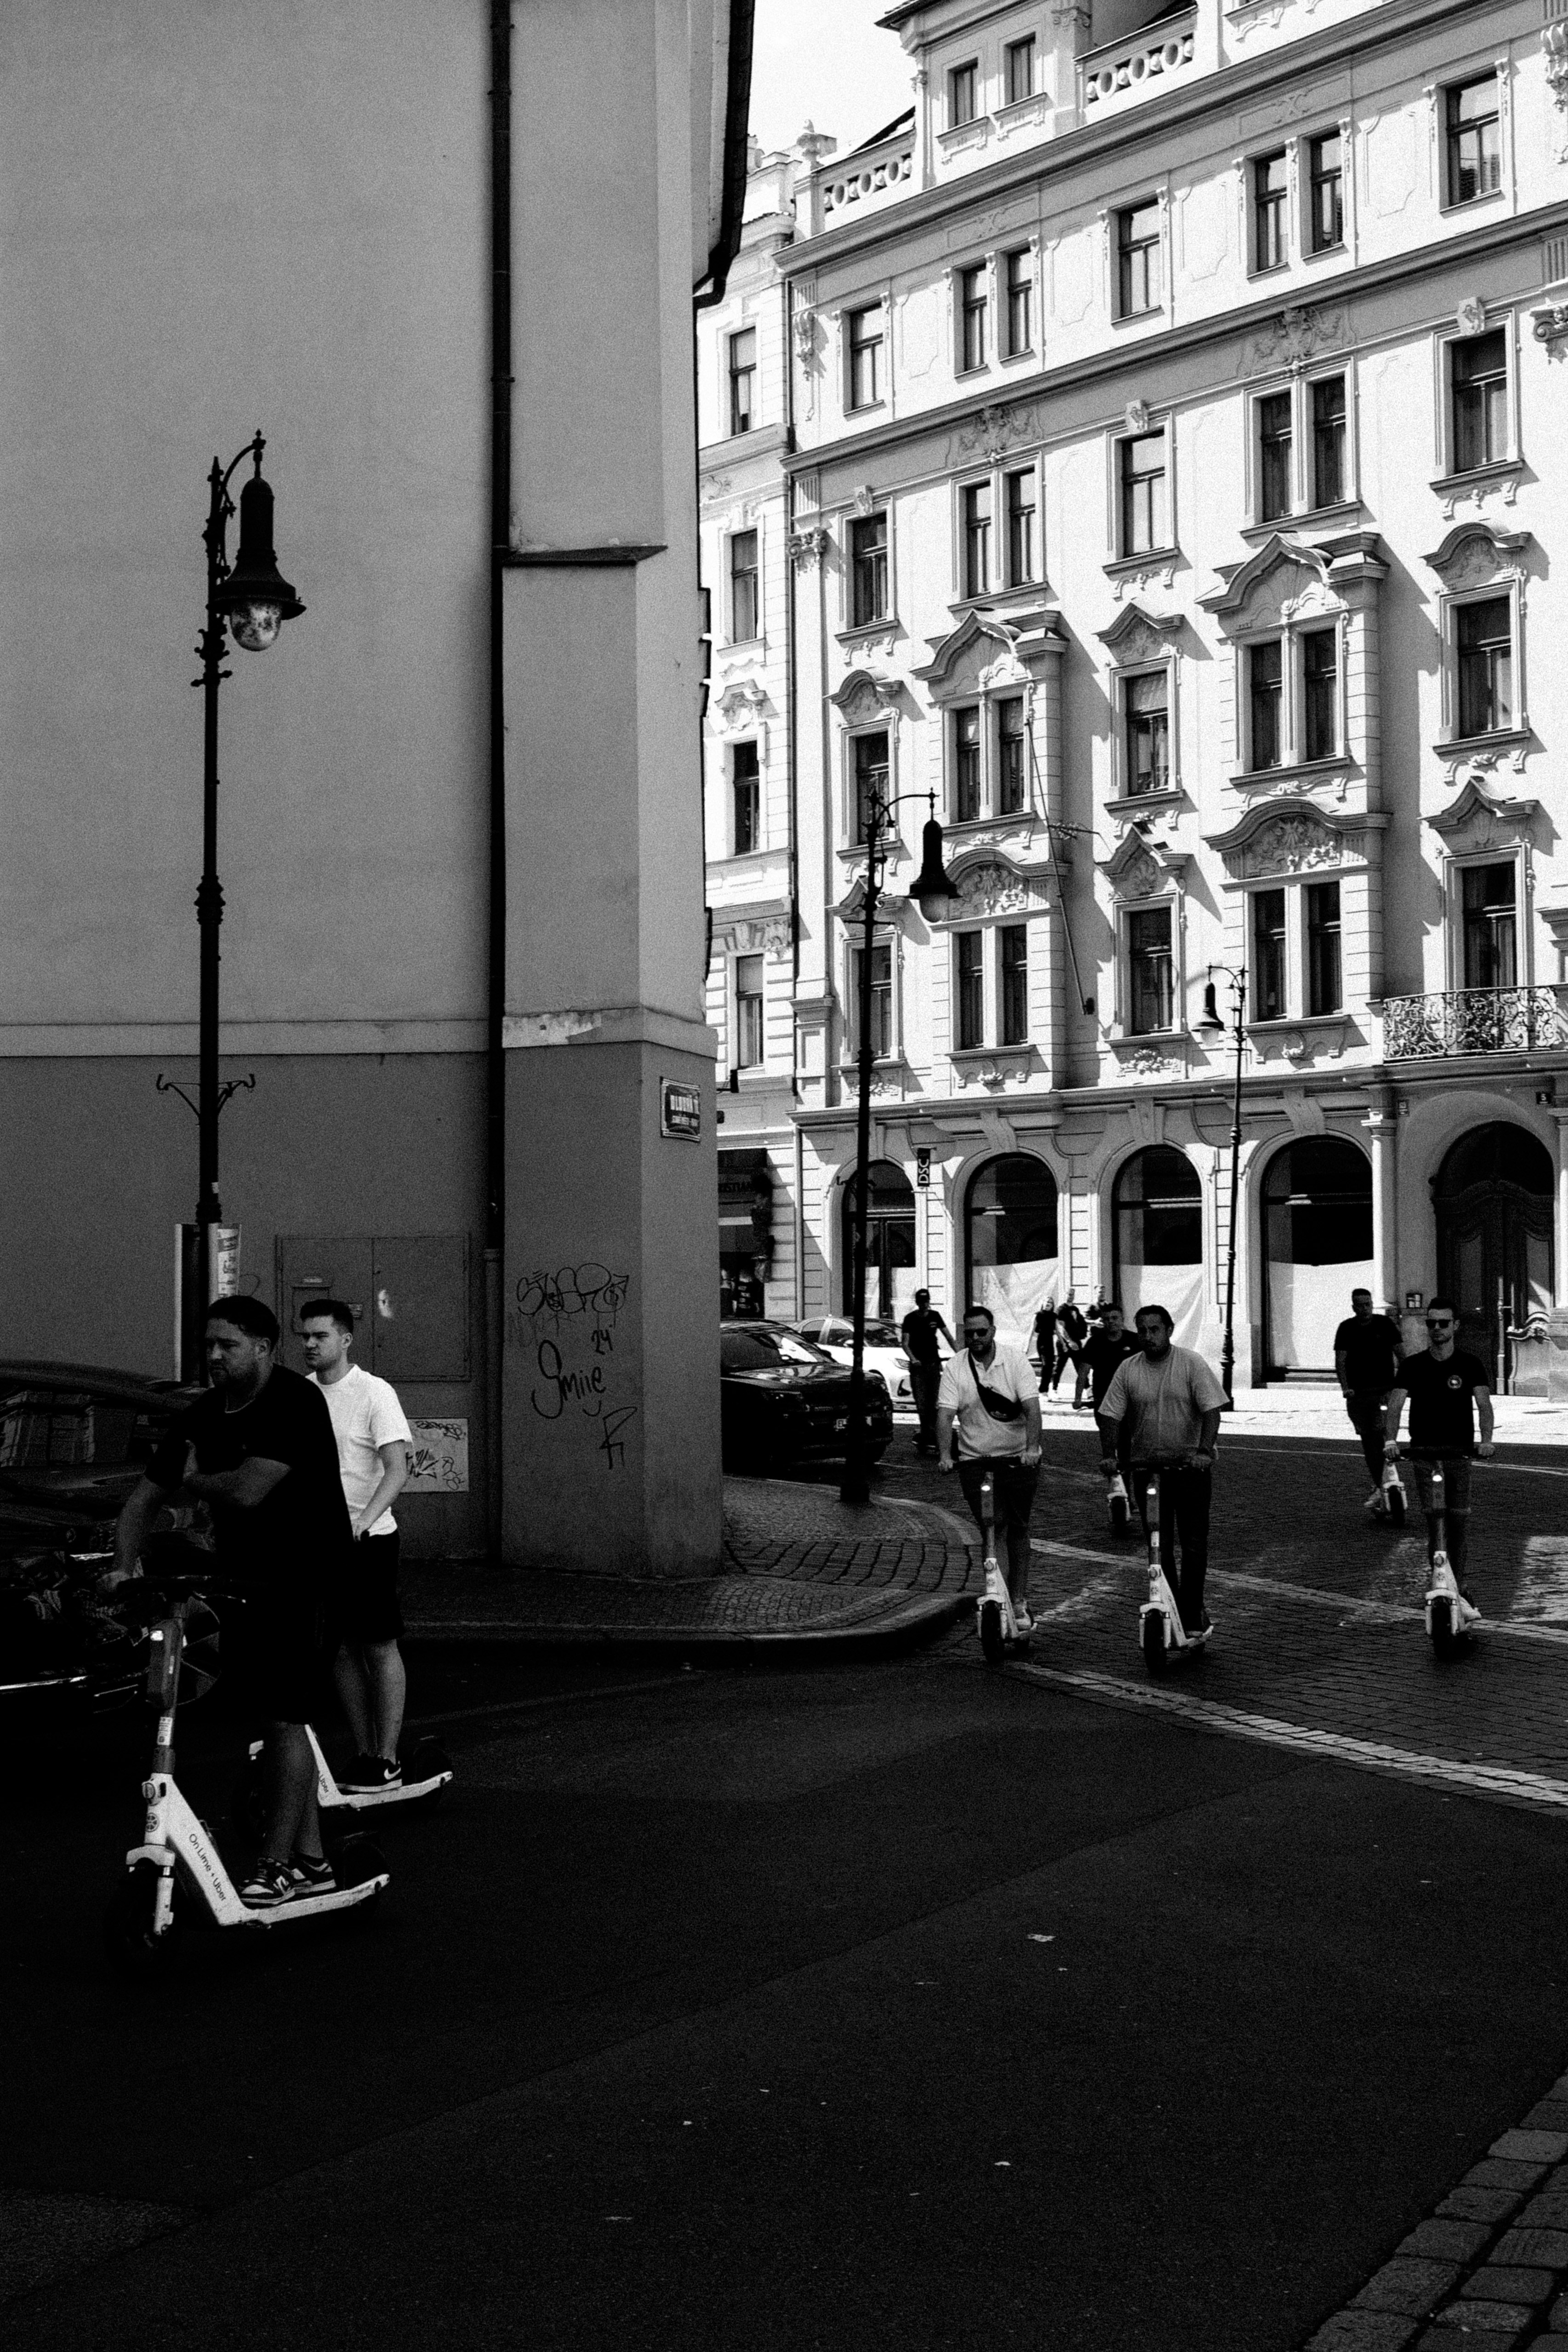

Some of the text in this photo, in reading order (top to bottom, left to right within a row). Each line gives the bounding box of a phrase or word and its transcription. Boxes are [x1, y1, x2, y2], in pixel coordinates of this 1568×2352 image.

[918, 1159, 929, 1183] DSC
[189, 1833, 199, 1850] On
[197, 1848, 211, 1872] Lime
[213, 1878, 227, 1901] Uber
